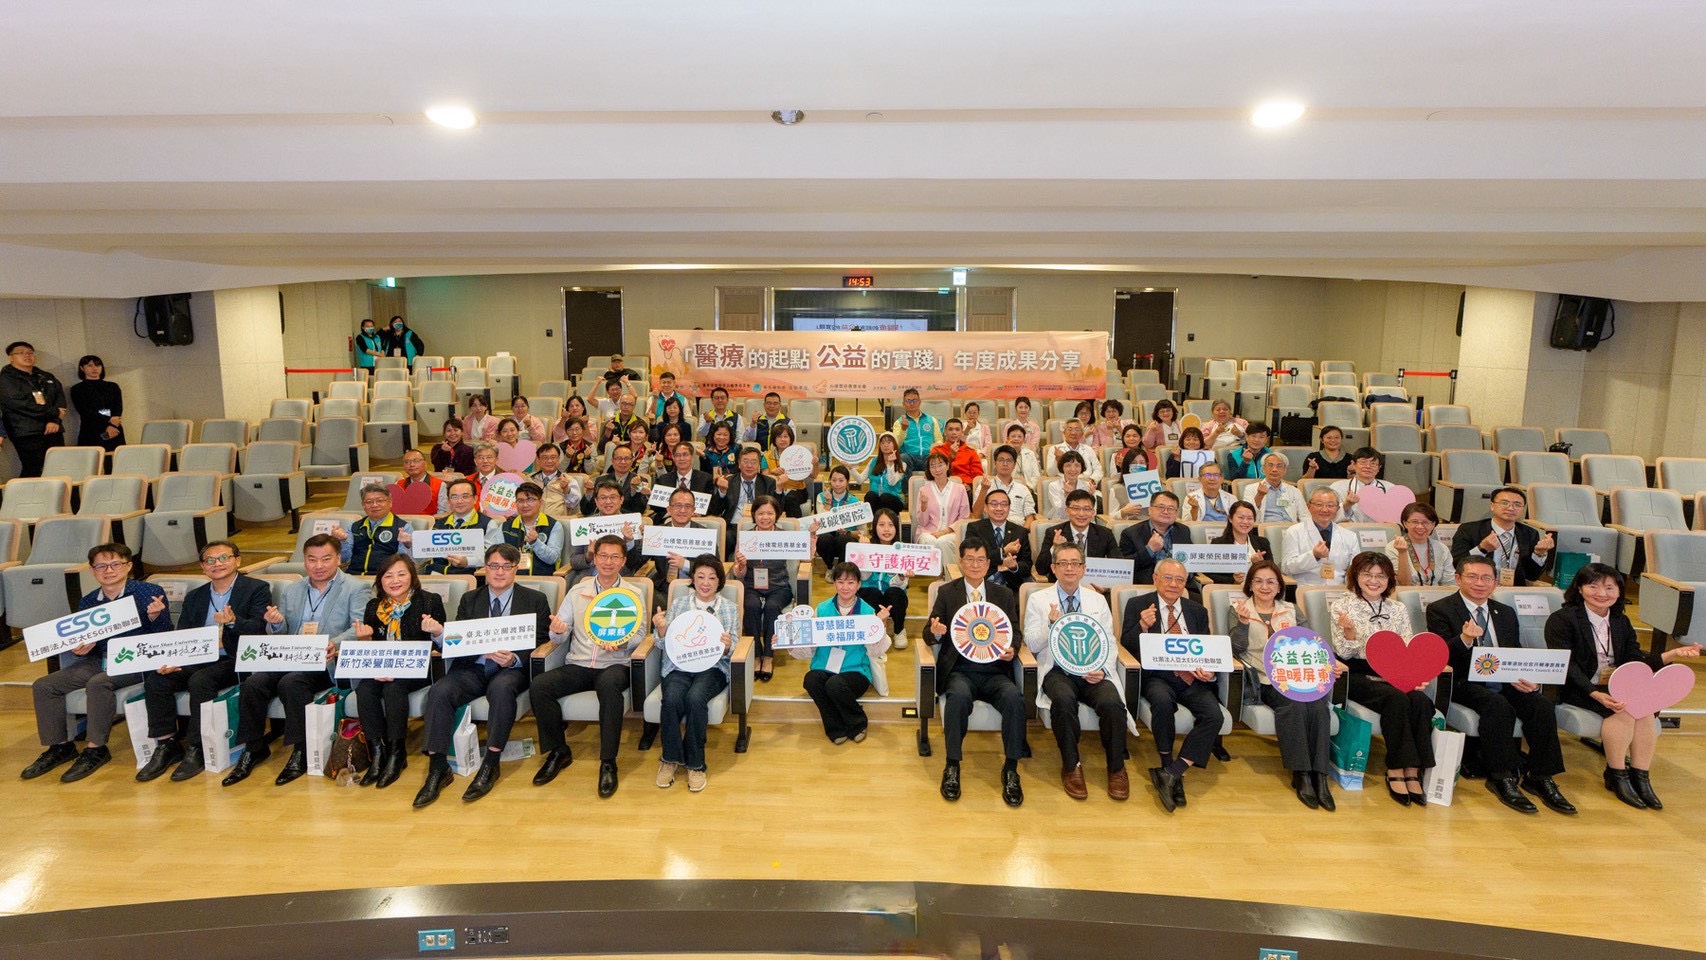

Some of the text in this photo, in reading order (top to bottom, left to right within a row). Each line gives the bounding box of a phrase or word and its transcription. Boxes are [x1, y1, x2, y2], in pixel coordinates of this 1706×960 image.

[847, 277, 871, 287] 14:53
[682, 343, 1081, 371] 「醫療的起點 公益的實踐」 年度成果分享
[1127, 480, 1162, 500] ESG
[432, 532, 463, 545] ESG
[664, 538, 713, 546] 台積電慈善基金會
[869, 553, 931, 571] 守護病安
[55, 607, 111, 638] ESG
[815, 619, 855, 630] 智慧醫起
[30, 616, 140, 658] 社團法人亞太ESG行動聯盟
[597, 627, 626, 637] 屏東縣
[826, 631, 865, 642] 幸福屏東
[676, 646, 721, 660] 台積電慈善基金會
[1165, 638, 1204, 655] ESG
[340, 658, 426, 669] 新竹榮譽國民之家
[1152, 656, 1222, 664] 社團法人亞太ESG行動聯盟
[1271, 650, 1328, 665] 公益台灣
[1272, 667, 1329, 683] 溫暖屏東
